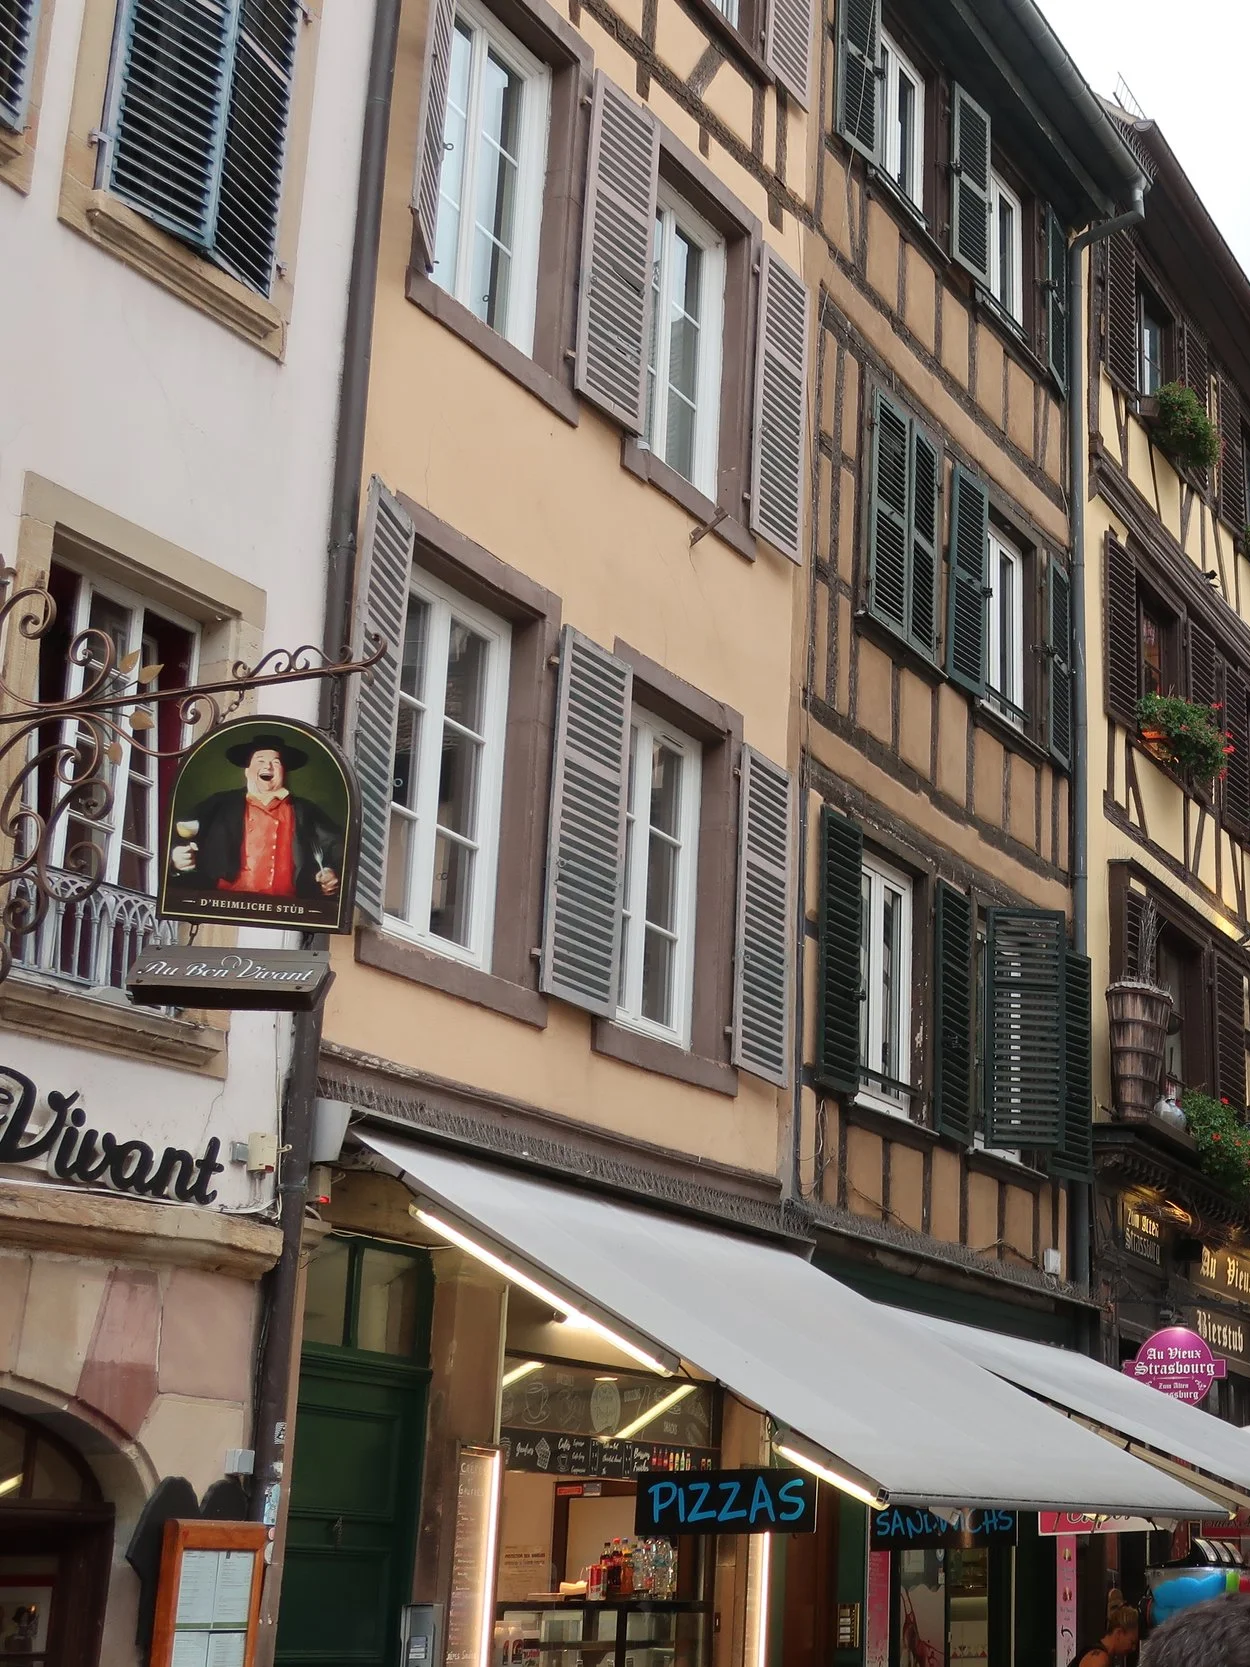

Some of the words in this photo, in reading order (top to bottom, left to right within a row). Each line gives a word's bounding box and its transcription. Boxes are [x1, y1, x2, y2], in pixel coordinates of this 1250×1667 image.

[200, 898, 273, 913] D'HEIMLICHE
[137, 960, 180, 977] Au
[184, 962, 229, 979] Bon
[220, 954, 315, 982] Vivant
[0, 1065, 224, 1204] Vivant
[1200, 1245, 1217, 1279] Au
[1196, 1310, 1244, 1353] Bierstub
[1134, 1361, 1215, 1376] Strasbourg
[1147, 1348, 1164, 1360] Au
[1168, 1348, 1201, 1359] Vieux
[648, 1476, 806, 1523] PIZZAS
